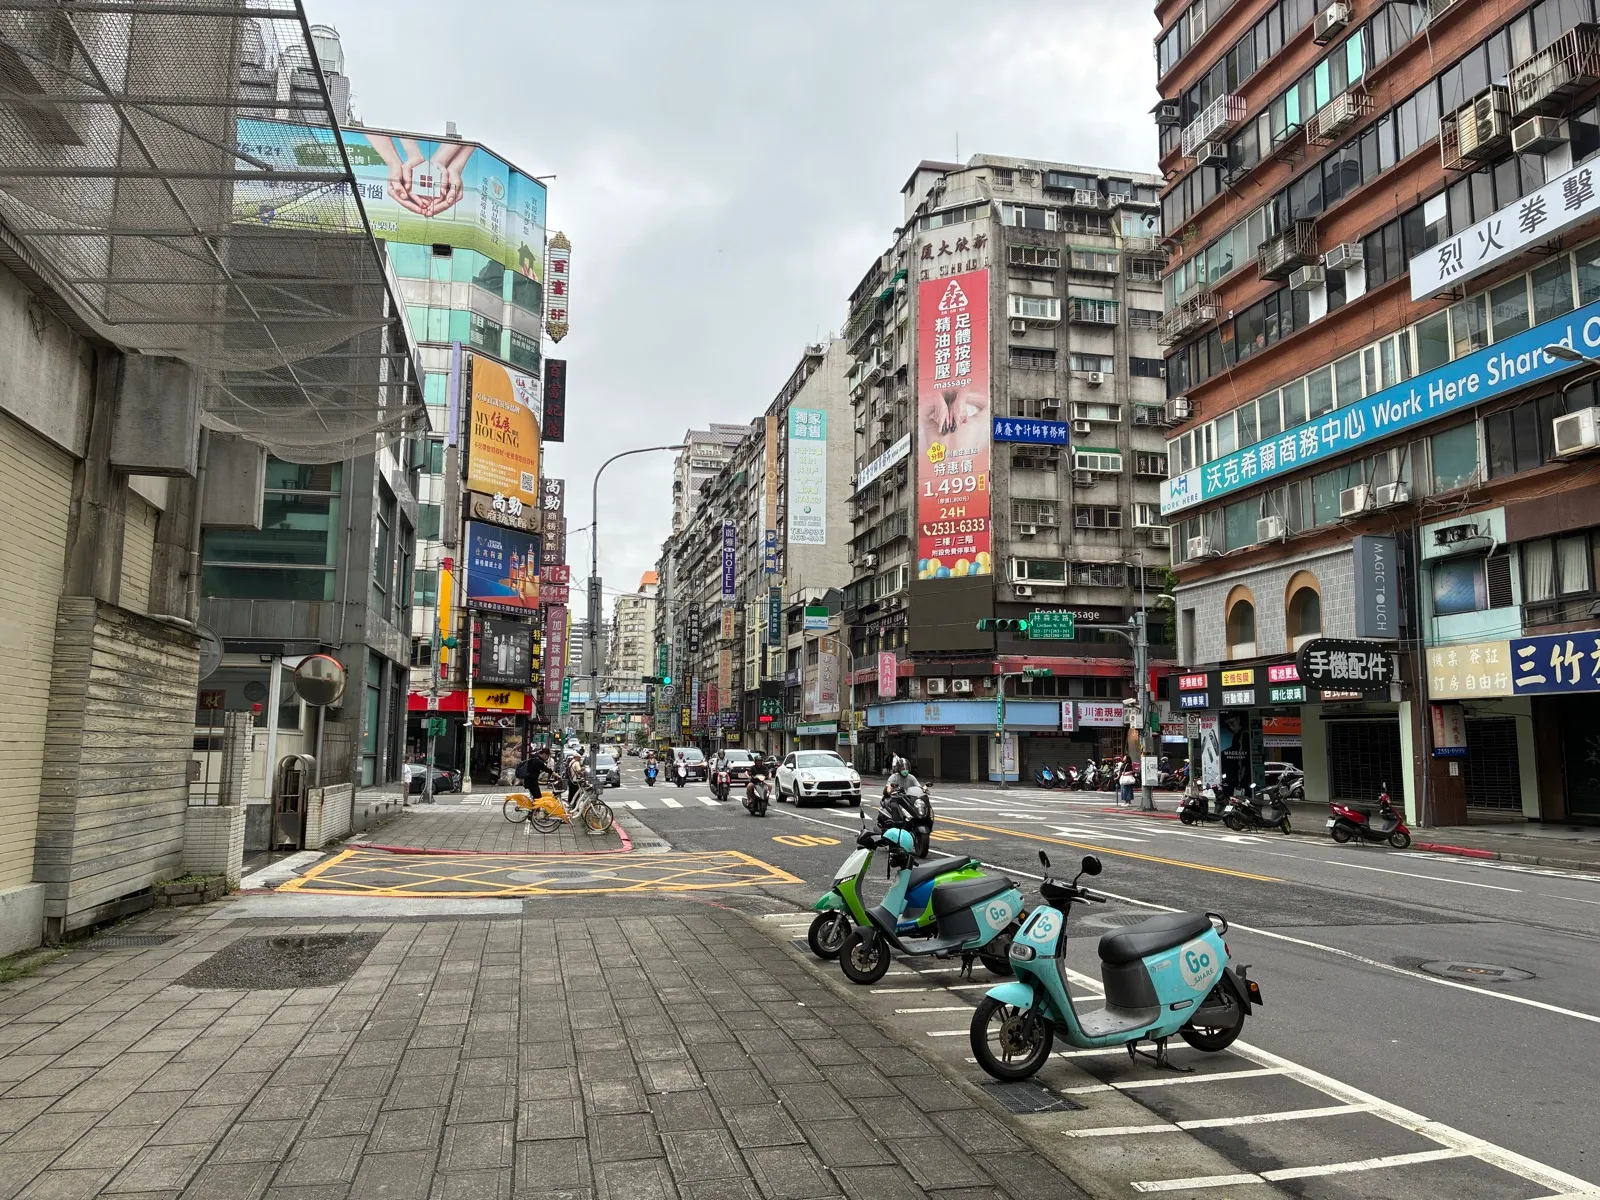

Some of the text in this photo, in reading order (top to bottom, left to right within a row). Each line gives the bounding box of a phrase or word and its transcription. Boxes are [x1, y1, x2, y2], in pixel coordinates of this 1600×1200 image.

[1438, 168, 1595, 280] 烈火拳擊
[935, 316, 951, 380] 精油舒壓
[955, 312, 972, 378] 足體按摩
[934, 378, 972, 390] massage
[1372, 389, 1422, 428] Work
[1428, 372, 1480, 408] Here
[1486, 324, 1574, 384] Shared
[475, 411, 490, 425] MY
[475, 423, 520, 448] HOUSING
[994, 422, 1066, 439] 廣鑫會計師事務所
[1206, 409, 1366, 494] 沃克希爾商務中心
[934, 460, 973, 476] 特惠價
[767, 459, 777, 517] HOTEL
[924, 476, 977, 498] 1,499
[1162, 493, 1198, 512] WORK HERE
[940, 506, 966, 518] 24H
[932, 518, 985, 536] 2531-6333
[544, 554, 558, 562] 2F
[766, 546, 776, 569] 停車
[1034, 614, 1069, 622] 林森北路
[1310, 651, 1386, 680] 手機配件
[531, 673, 539, 682] 5F
[1434, 672, 1508, 692] 訂房 自由行
[1224, 693, 1250, 704] 行動電源
[1272, 689, 1302, 700] 鋼化玻璃
[1085, 706, 1122, 718] 川渝現撈
[990, 907, 1007, 921] Go
[1036, 916, 1052, 932] Go
[1185, 950, 1210, 974] Go
[1194, 968, 1214, 985] SHARE
